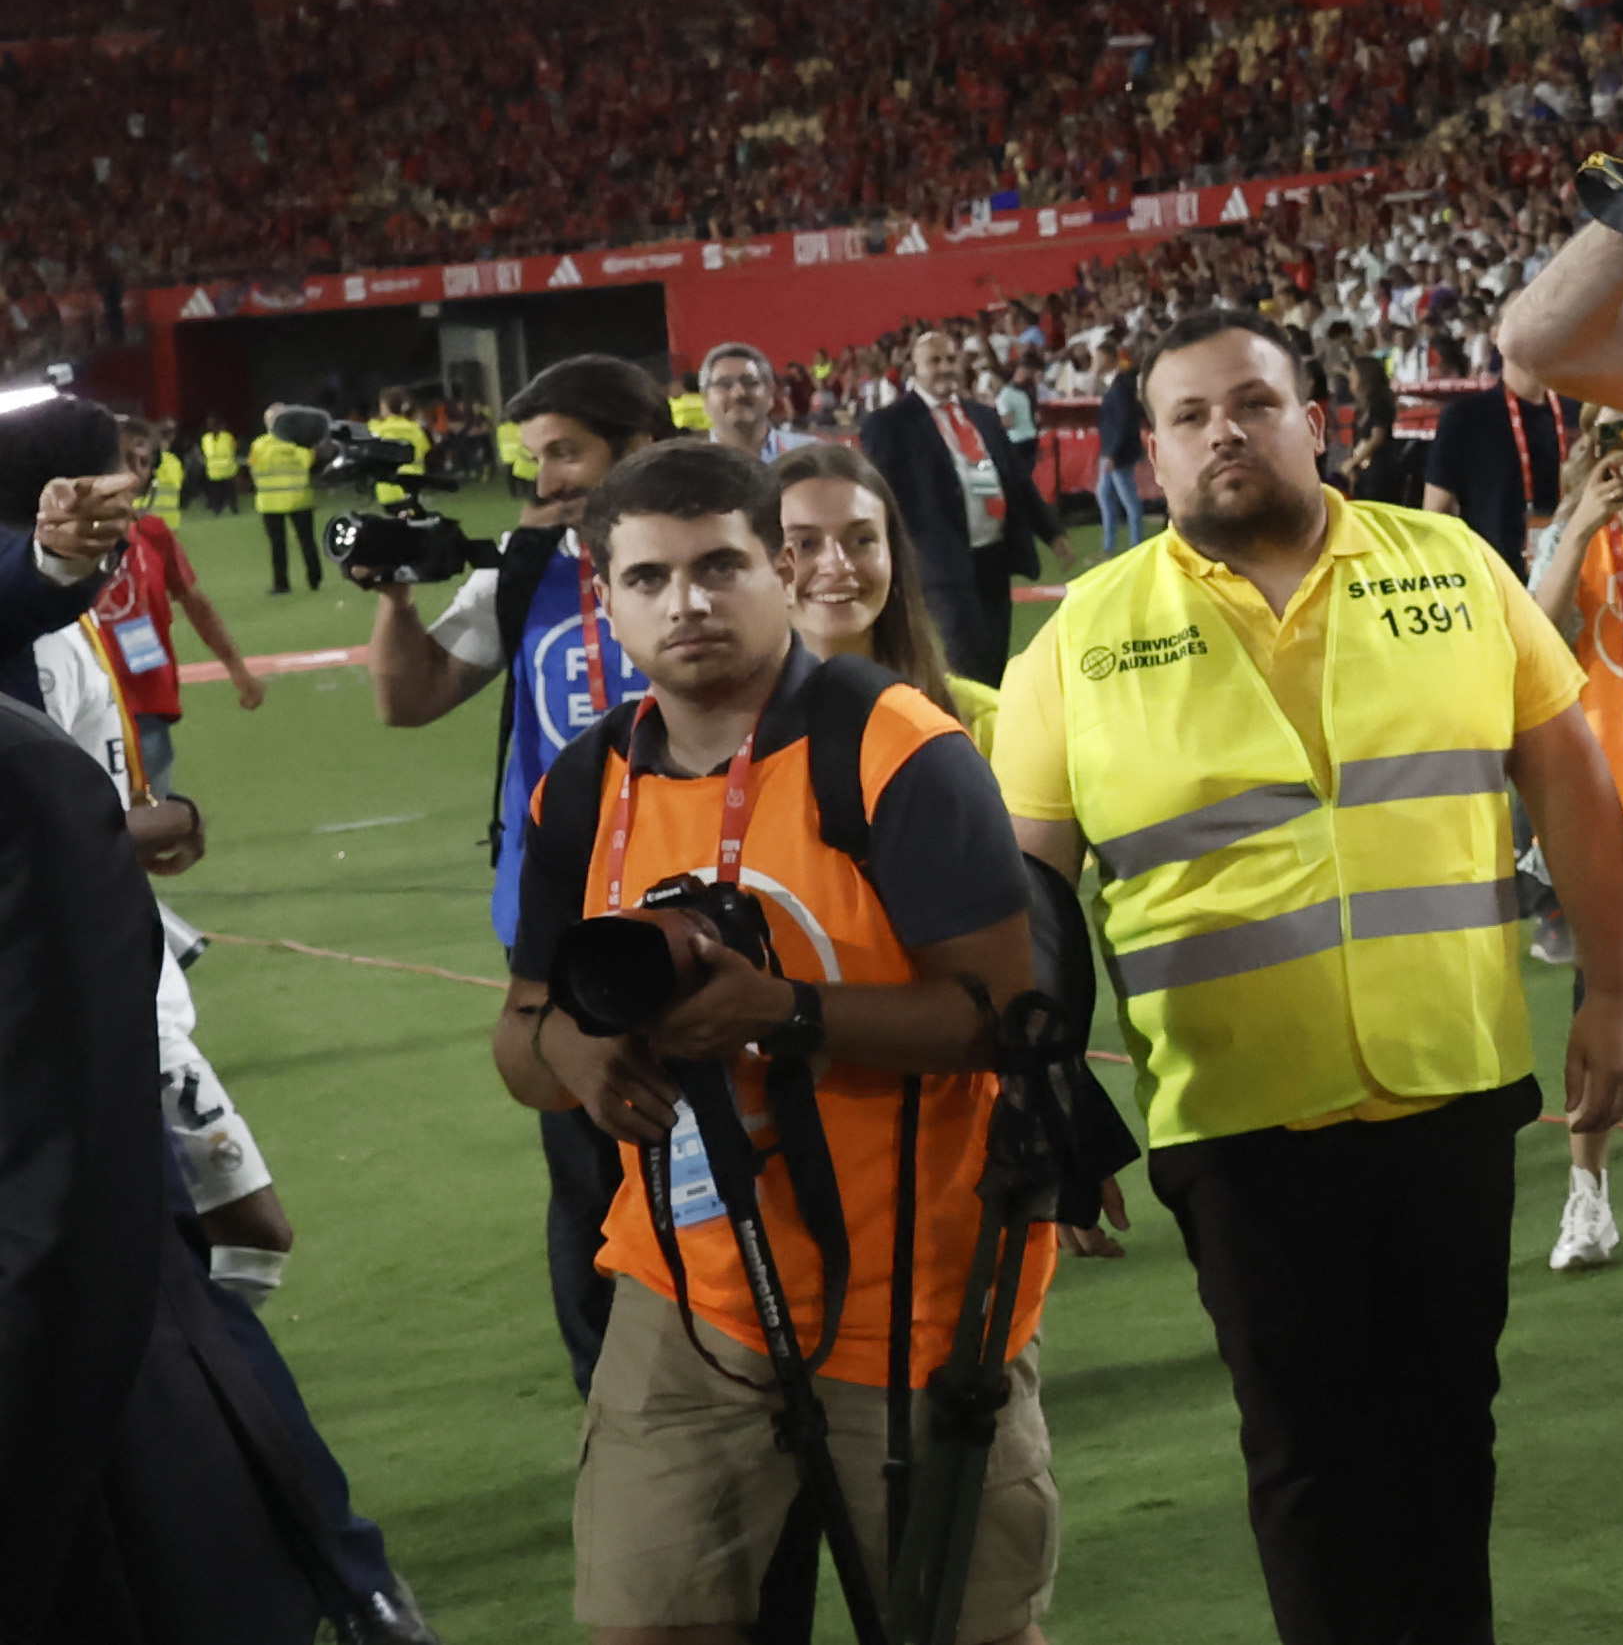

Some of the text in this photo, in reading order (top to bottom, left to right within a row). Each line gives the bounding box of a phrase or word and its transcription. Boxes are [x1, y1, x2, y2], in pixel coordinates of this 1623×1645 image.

[1348, 572, 1468, 601] STEWARD
[1379, 601, 1474, 641] 1391
[1121, 624, 1200, 655] SERVICIOS
[1118, 640, 1209, 674] AUXILIARES
[646, 886, 682, 904] Canon
